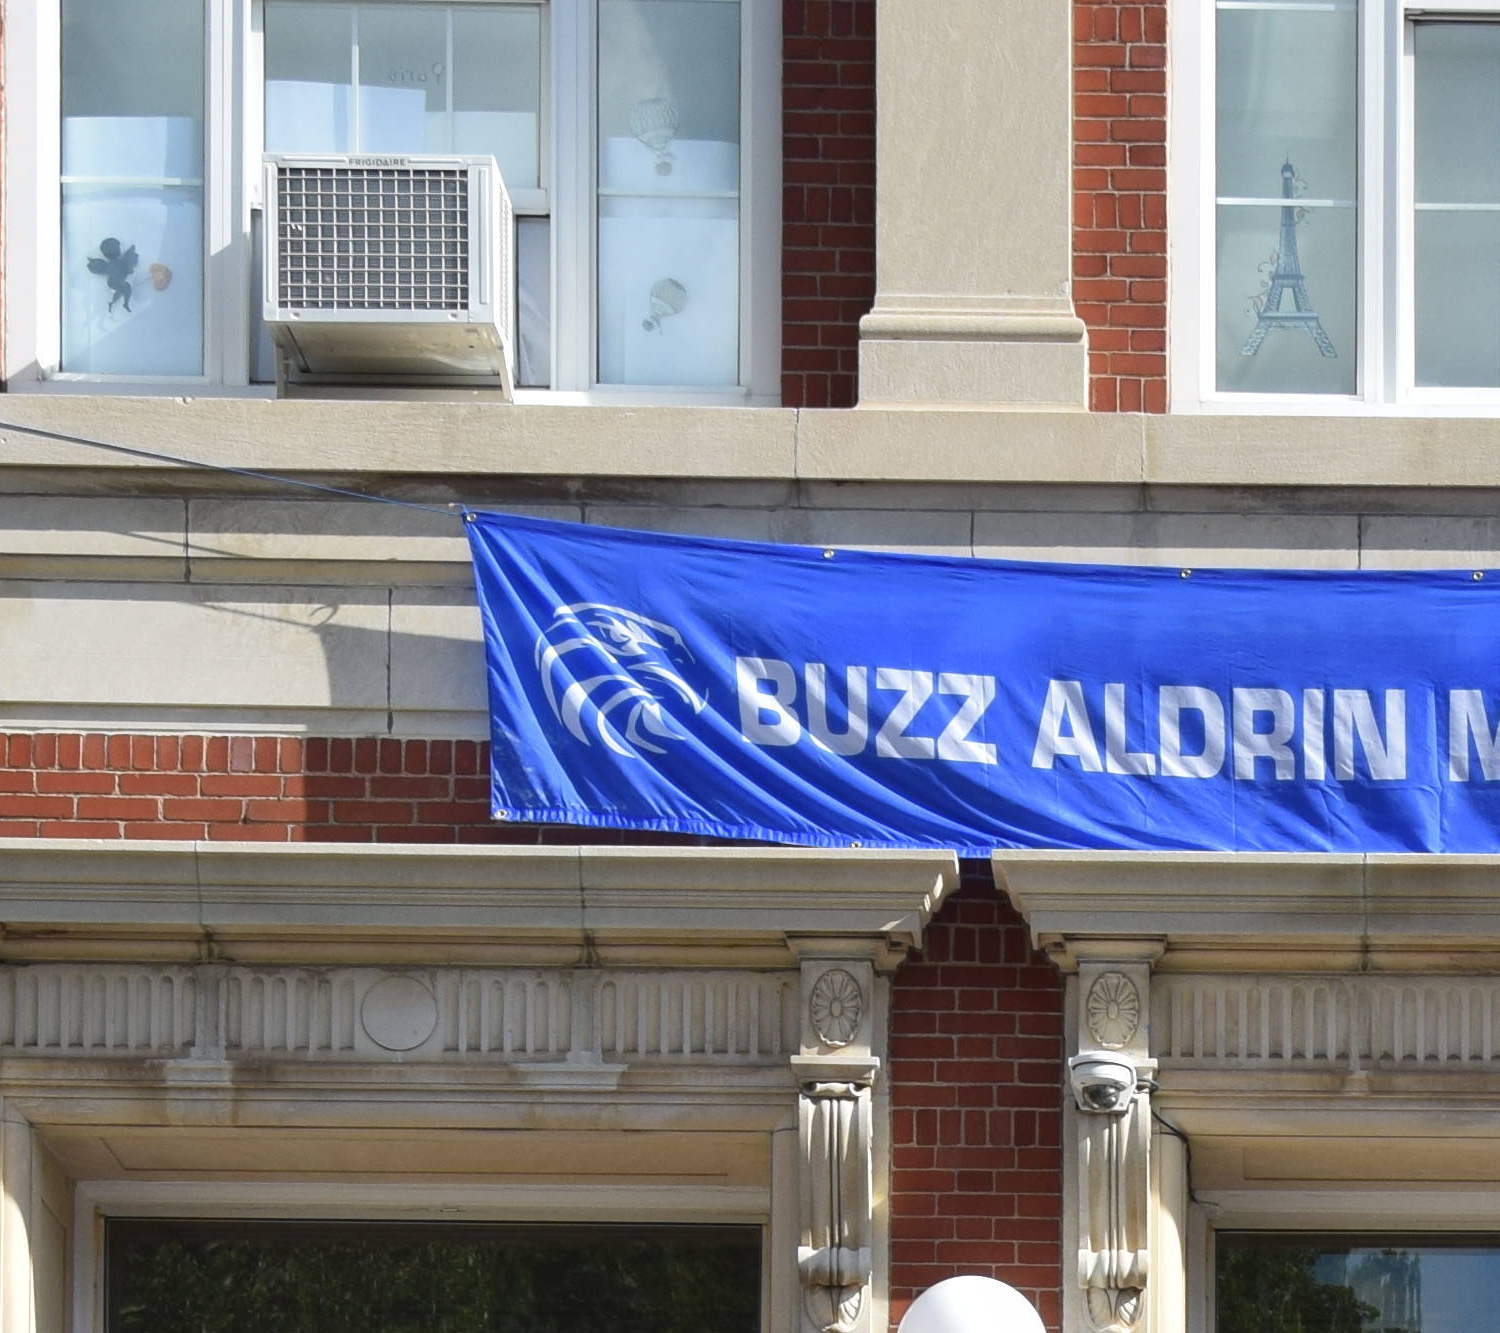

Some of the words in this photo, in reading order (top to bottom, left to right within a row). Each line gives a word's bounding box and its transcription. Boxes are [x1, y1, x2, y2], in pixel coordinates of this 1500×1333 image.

[348, 158, 406, 167] FRIGIDAIRE
[734, 656, 999, 768] BUZZ
[1032, 679, 1407, 781] ALDRIN
